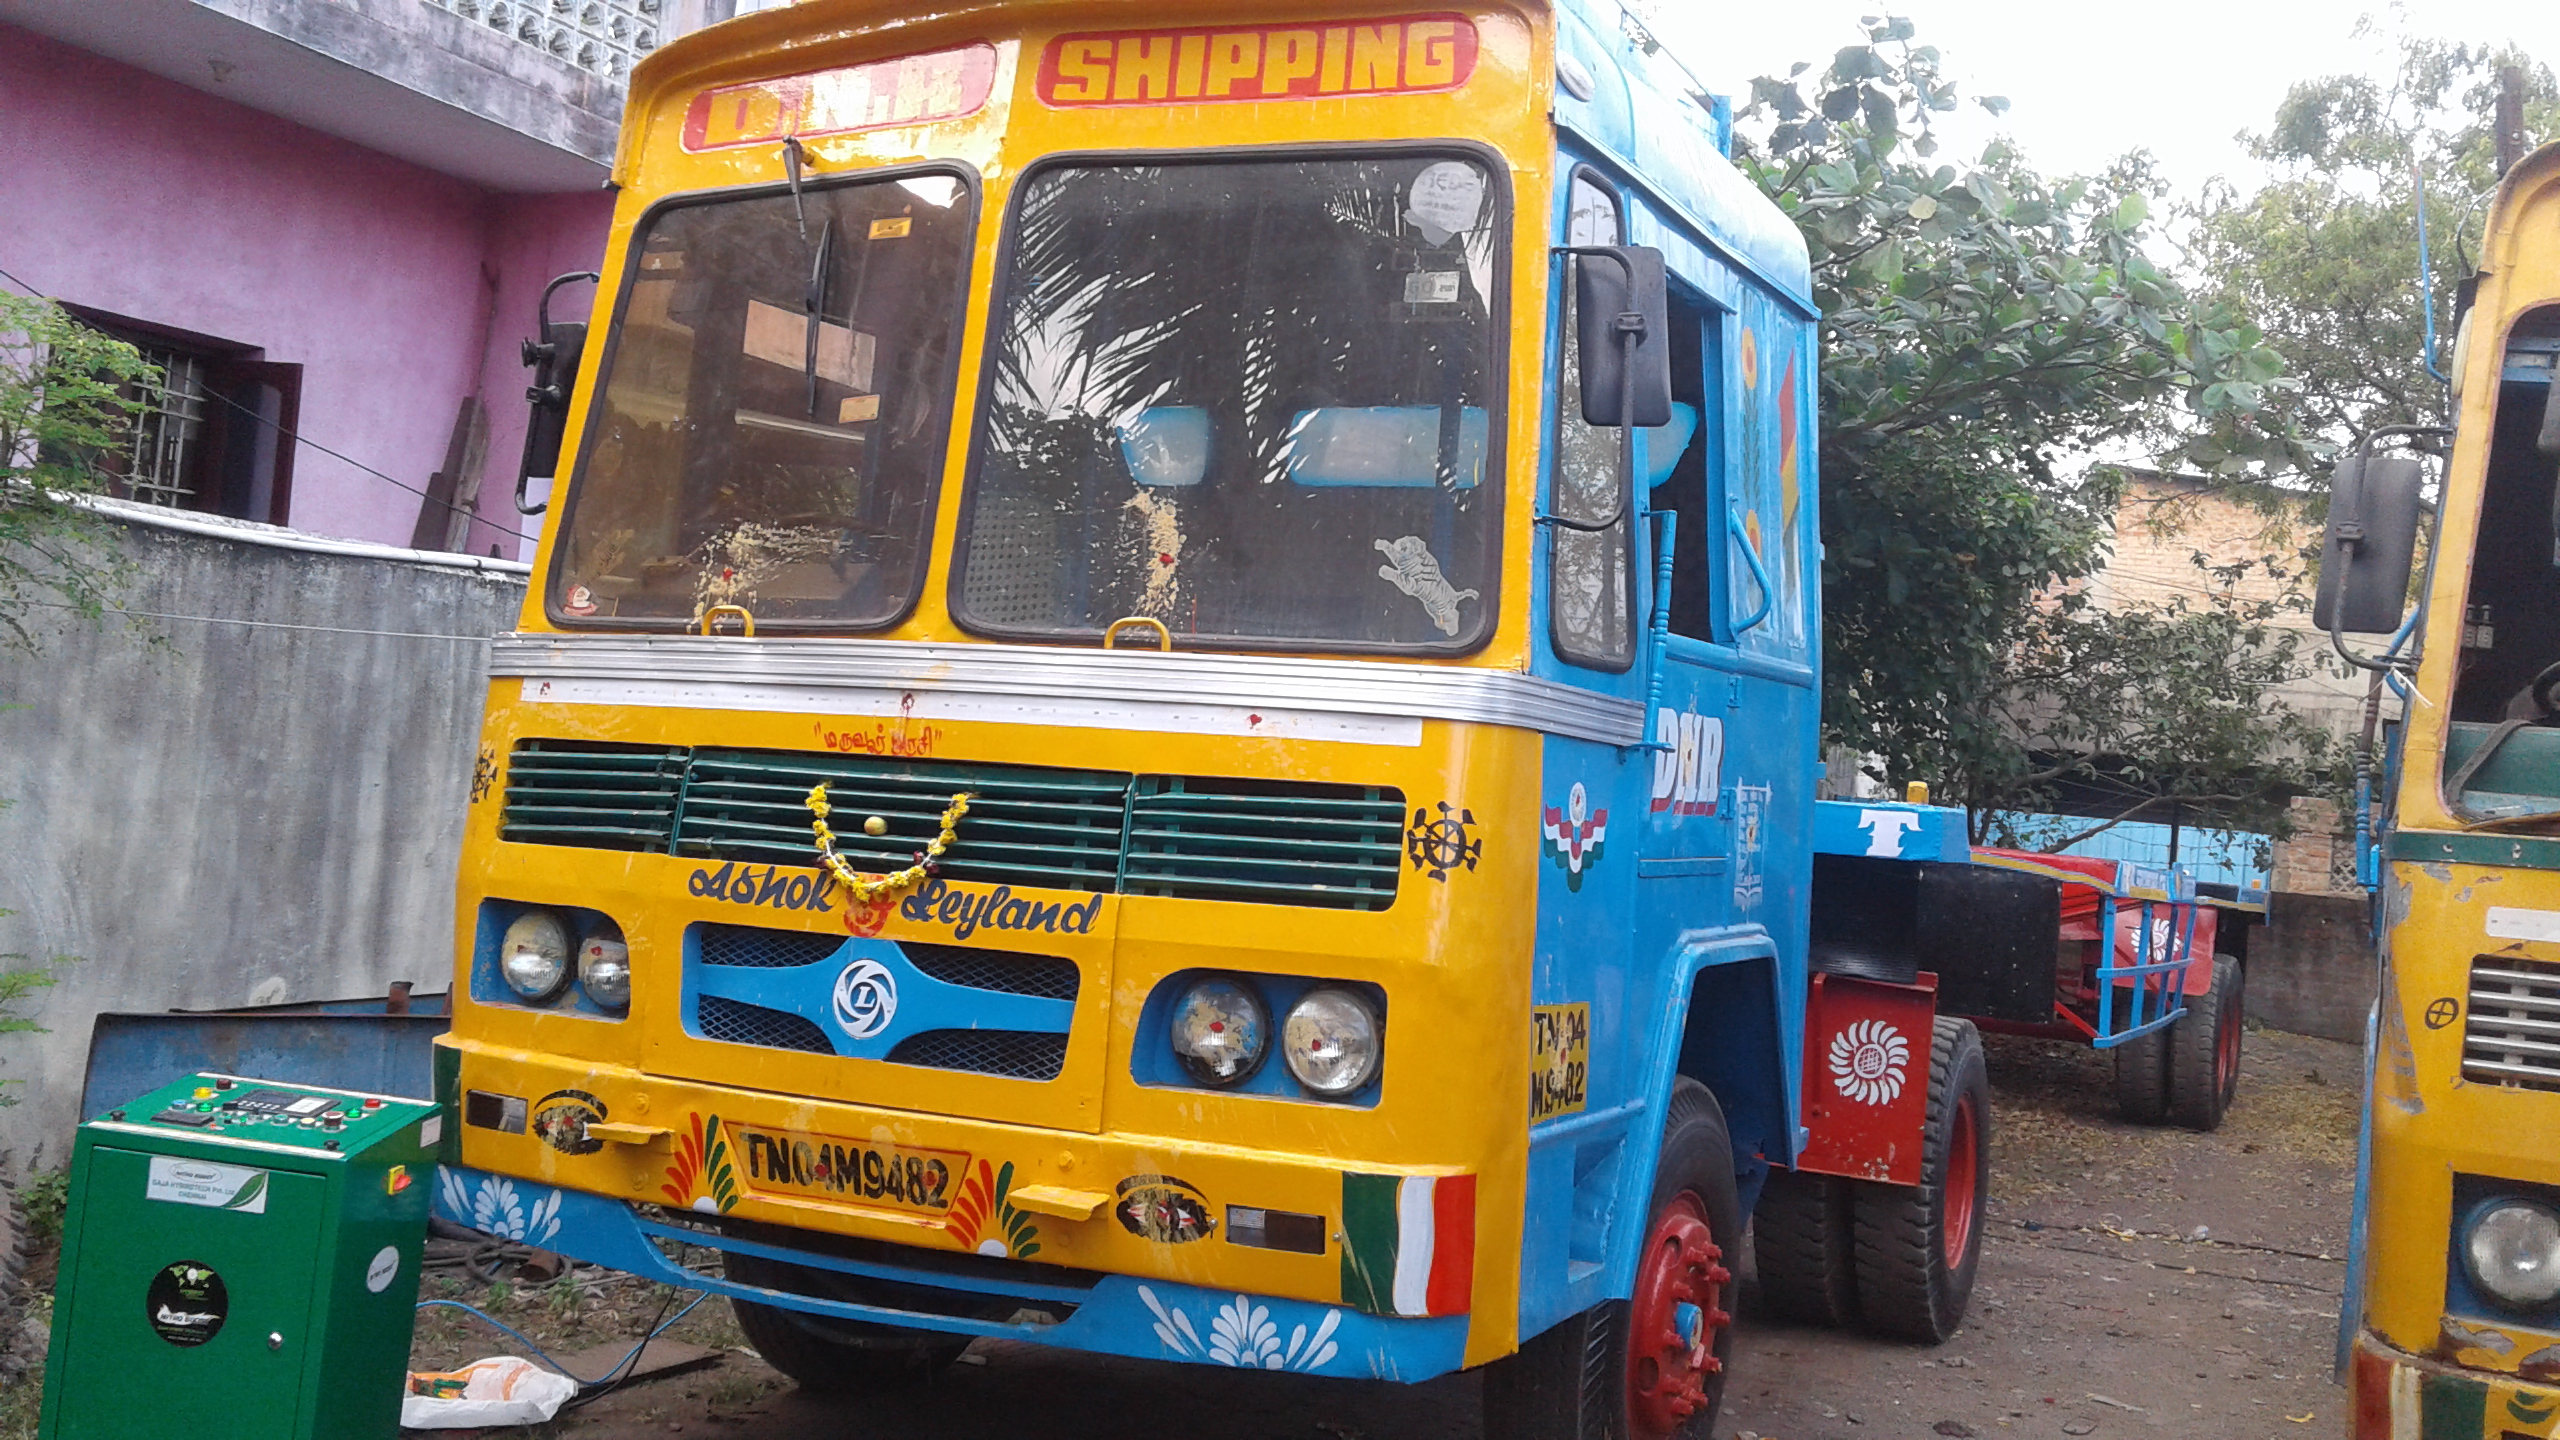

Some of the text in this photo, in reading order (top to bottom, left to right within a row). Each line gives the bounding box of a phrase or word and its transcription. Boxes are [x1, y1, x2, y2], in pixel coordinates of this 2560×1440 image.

[1051, 20, 1457, 103] SHIPPING
[1650, 707, 1724, 816] DNR
[1857, 808, 1923, 858] T
[687, 861, 838, 913] Ashok
[900, 878, 1104, 941] Leyland
[854, 985, 876, 1008] L
